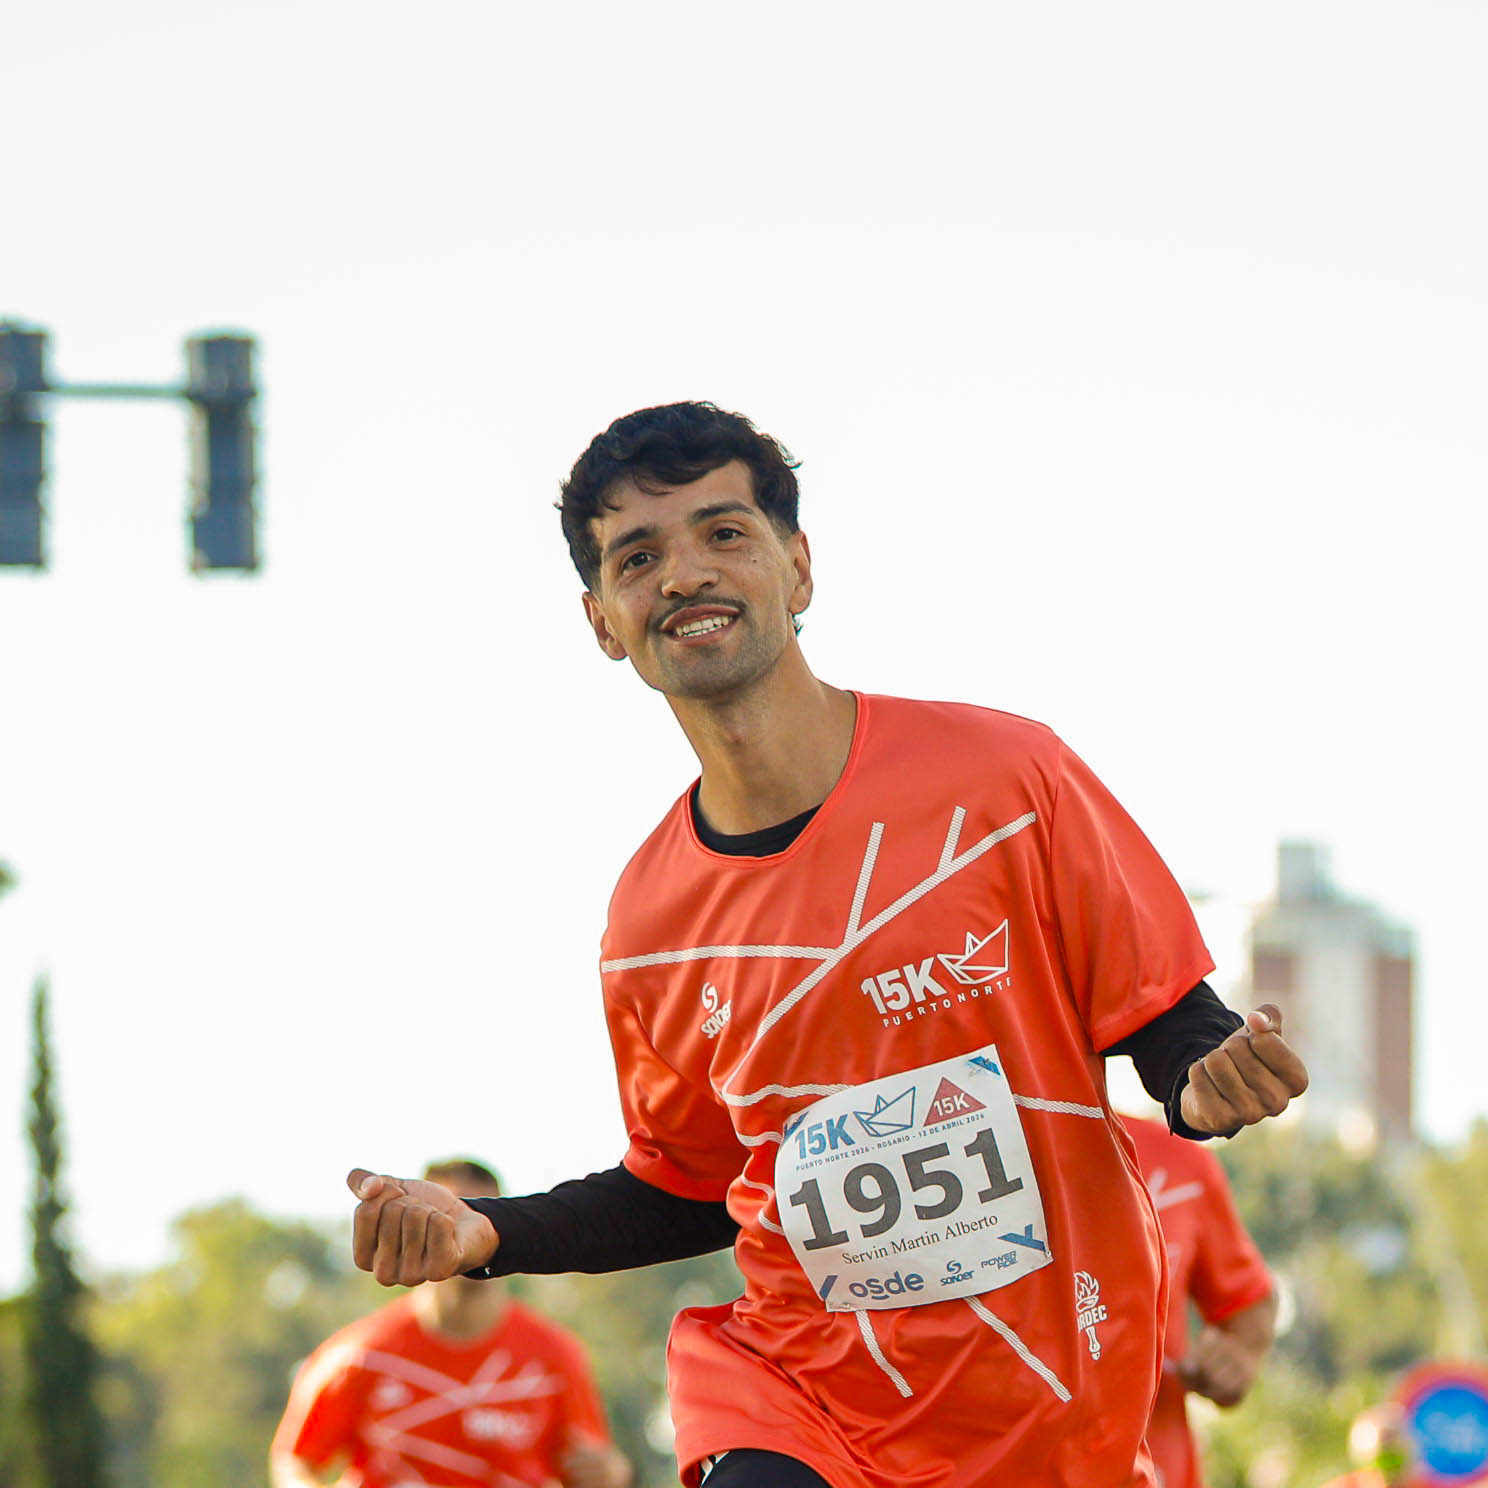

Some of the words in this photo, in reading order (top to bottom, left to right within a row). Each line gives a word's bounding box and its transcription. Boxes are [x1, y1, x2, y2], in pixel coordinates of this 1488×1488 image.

[861, 957, 948, 1015] 15K
[882, 999, 951, 1029] PUERTO
[957, 977, 1012, 1003] NORTE
[932, 1092, 971, 1117] 15K
[795, 1113, 856, 1159] 15K
[825, 1151, 849, 1163] NORTE
[877, 1136, 910, 1149] ROSARIO
[918, 1130, 928, 1139] 12
[942, 1119, 964, 1132] ABRIL
[789, 1128, 1024, 1251] 1951
[841, 1246, 890, 1265] Servin
[891, 1231, 941, 1254] Martin
[945, 1214, 999, 1238] Alberto
[848, 1270, 925, 1300] osde
